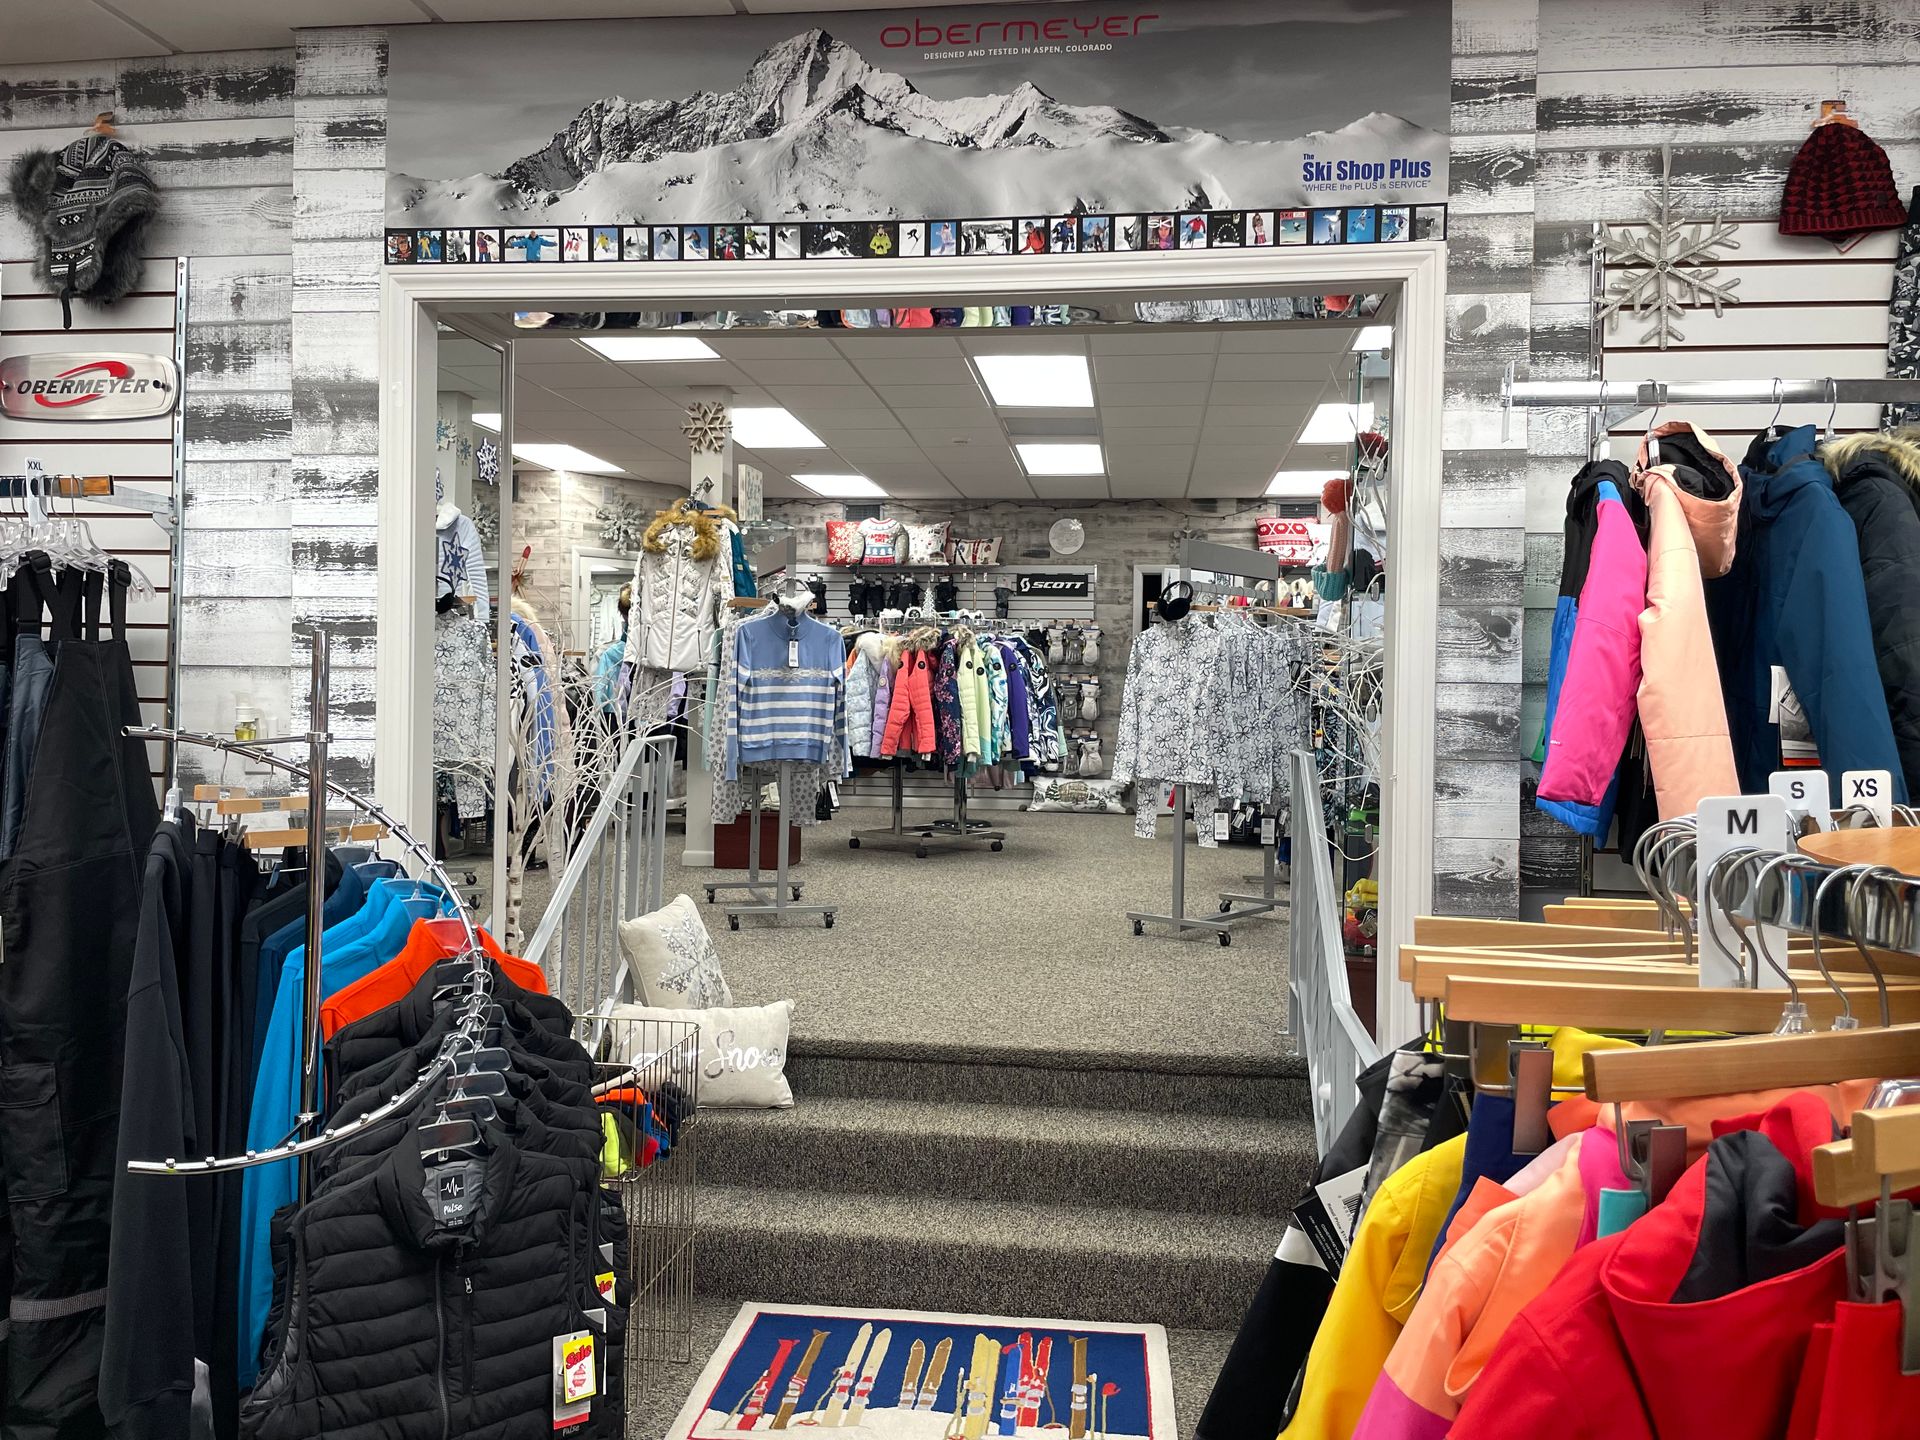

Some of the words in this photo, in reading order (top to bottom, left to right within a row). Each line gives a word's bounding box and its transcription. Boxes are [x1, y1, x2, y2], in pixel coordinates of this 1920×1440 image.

[924, 51, 965, 60] DESIGNED
[988, 48, 1019, 56] TESTED
[1033, 46, 1063, 54] ASPEN,
[1065, 44, 1113, 53] COLORADO
[1302, 161, 1332, 182] Ski
[1336, 160, 1385, 182] Shop
[1390, 158, 1431, 179] Plus
[1302, 183, 1337, 192] "WHERE
[1340, 183, 1352, 191] the
[1354, 181, 1378, 190] PLUS
[1380, 181, 1387, 189] is
[1389, 180, 1431, 189] SERVICE"
[17, 379, 150, 394] OBERMEYER
[27, 460, 43, 471] XXL
[1031, 581, 1084, 589] SCOTT
[1790, 781, 1805, 799] S
[1852, 778, 1878, 798] XS
[1727, 808, 1758, 835] M
[565, 1345, 592, 1370] Sale
